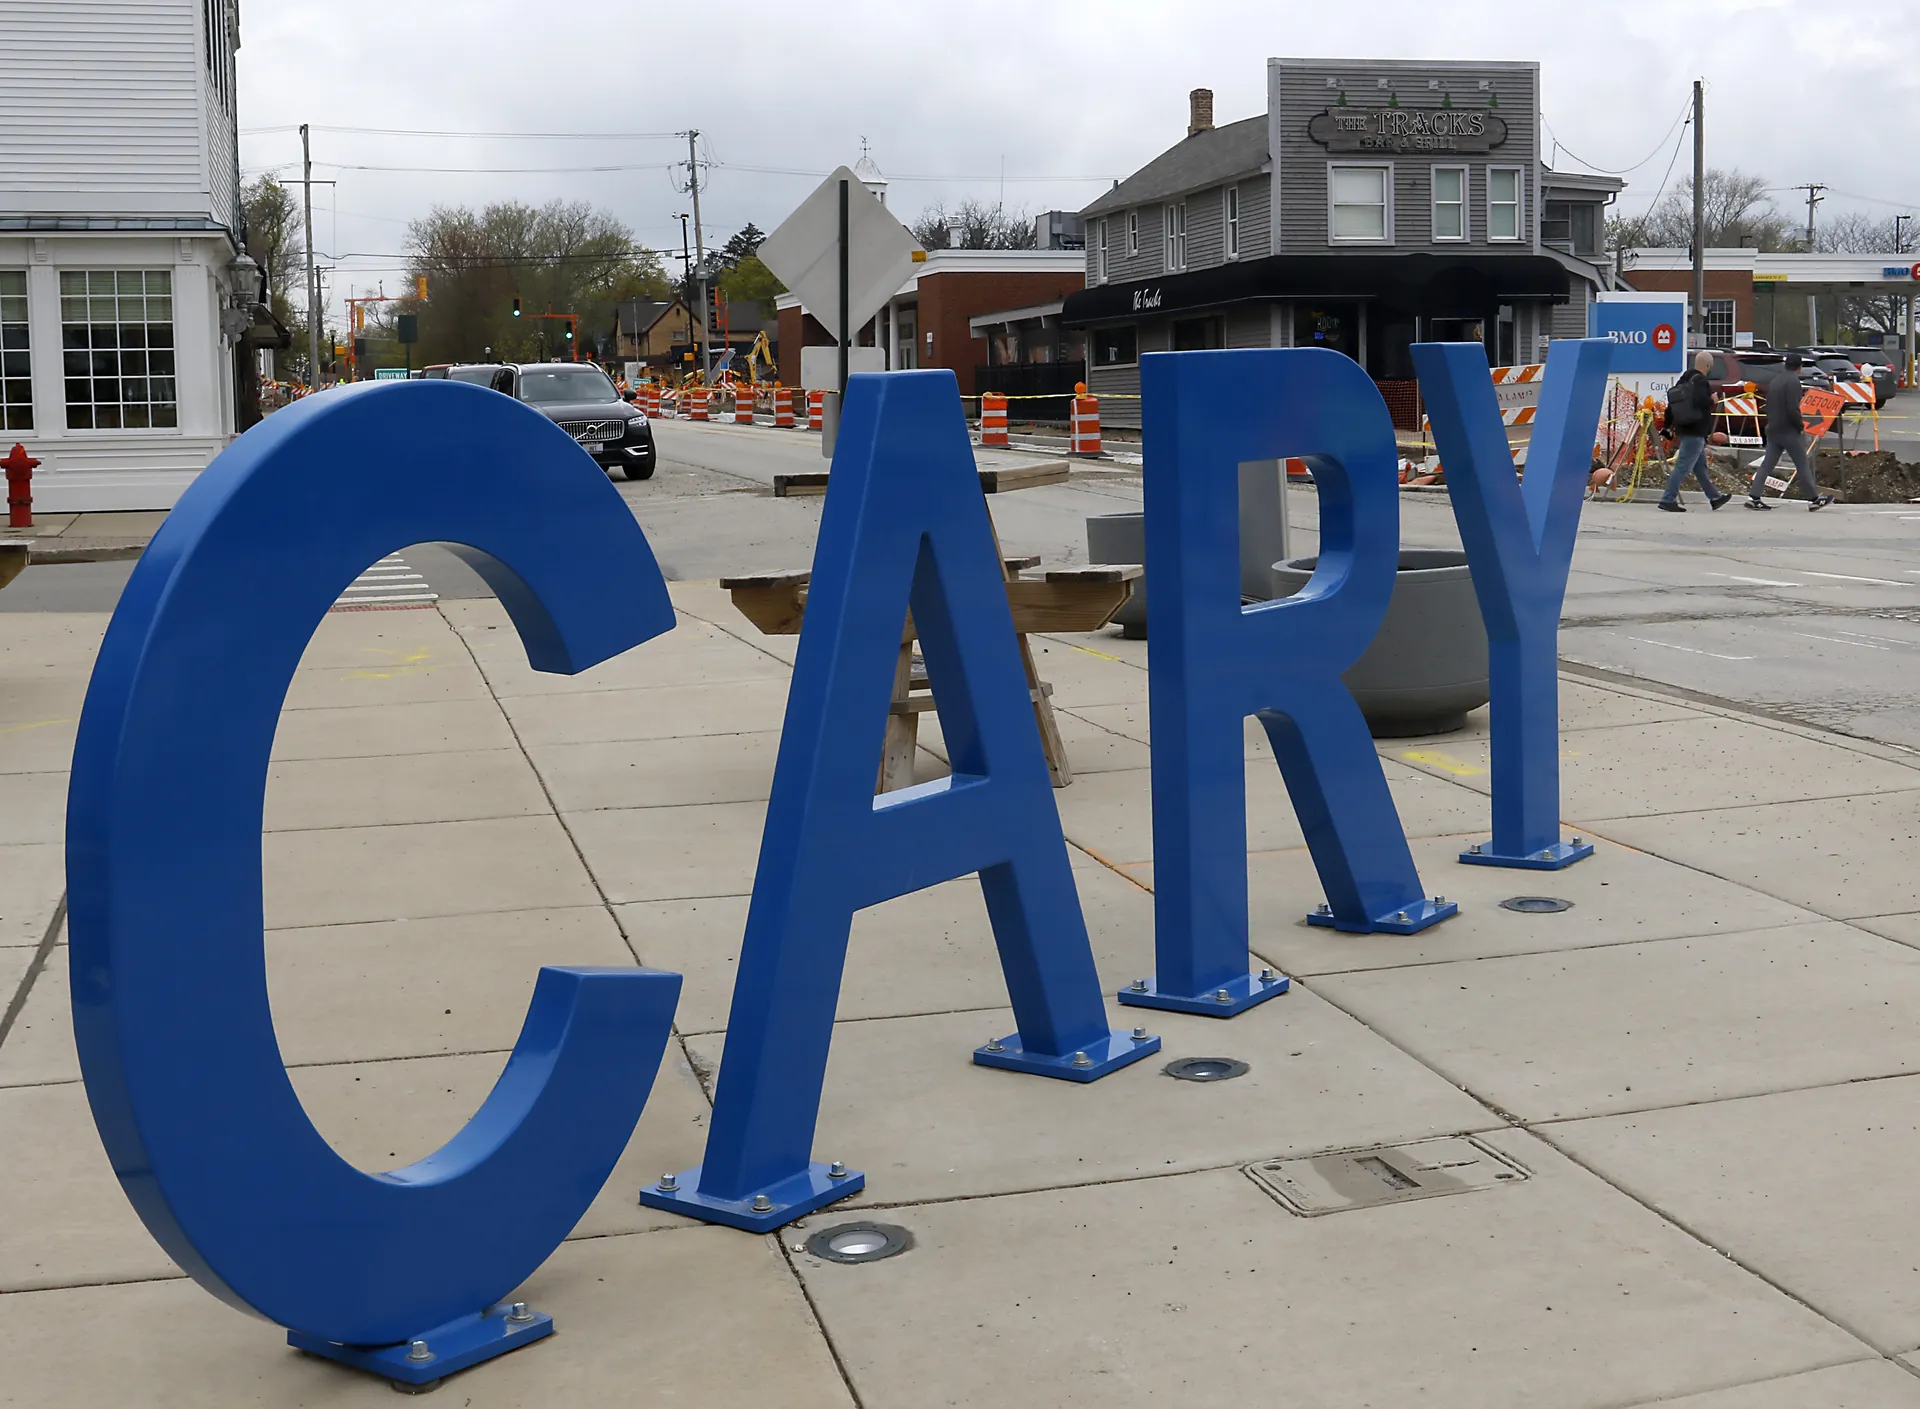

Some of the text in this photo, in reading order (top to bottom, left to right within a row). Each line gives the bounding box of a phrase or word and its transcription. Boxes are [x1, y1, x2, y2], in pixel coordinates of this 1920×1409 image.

[1335, 111, 1485, 137] THE TRACKS
[1400, 137, 1409, 148] &
[1607, 330, 1647, 345] BMO
[378, 372, 407, 380] DRIVEWAY
[1650, 381, 1669, 393] Cary
[1804, 394, 1841, 411] DETOUR
[66, 337, 1613, 1347] CARY
